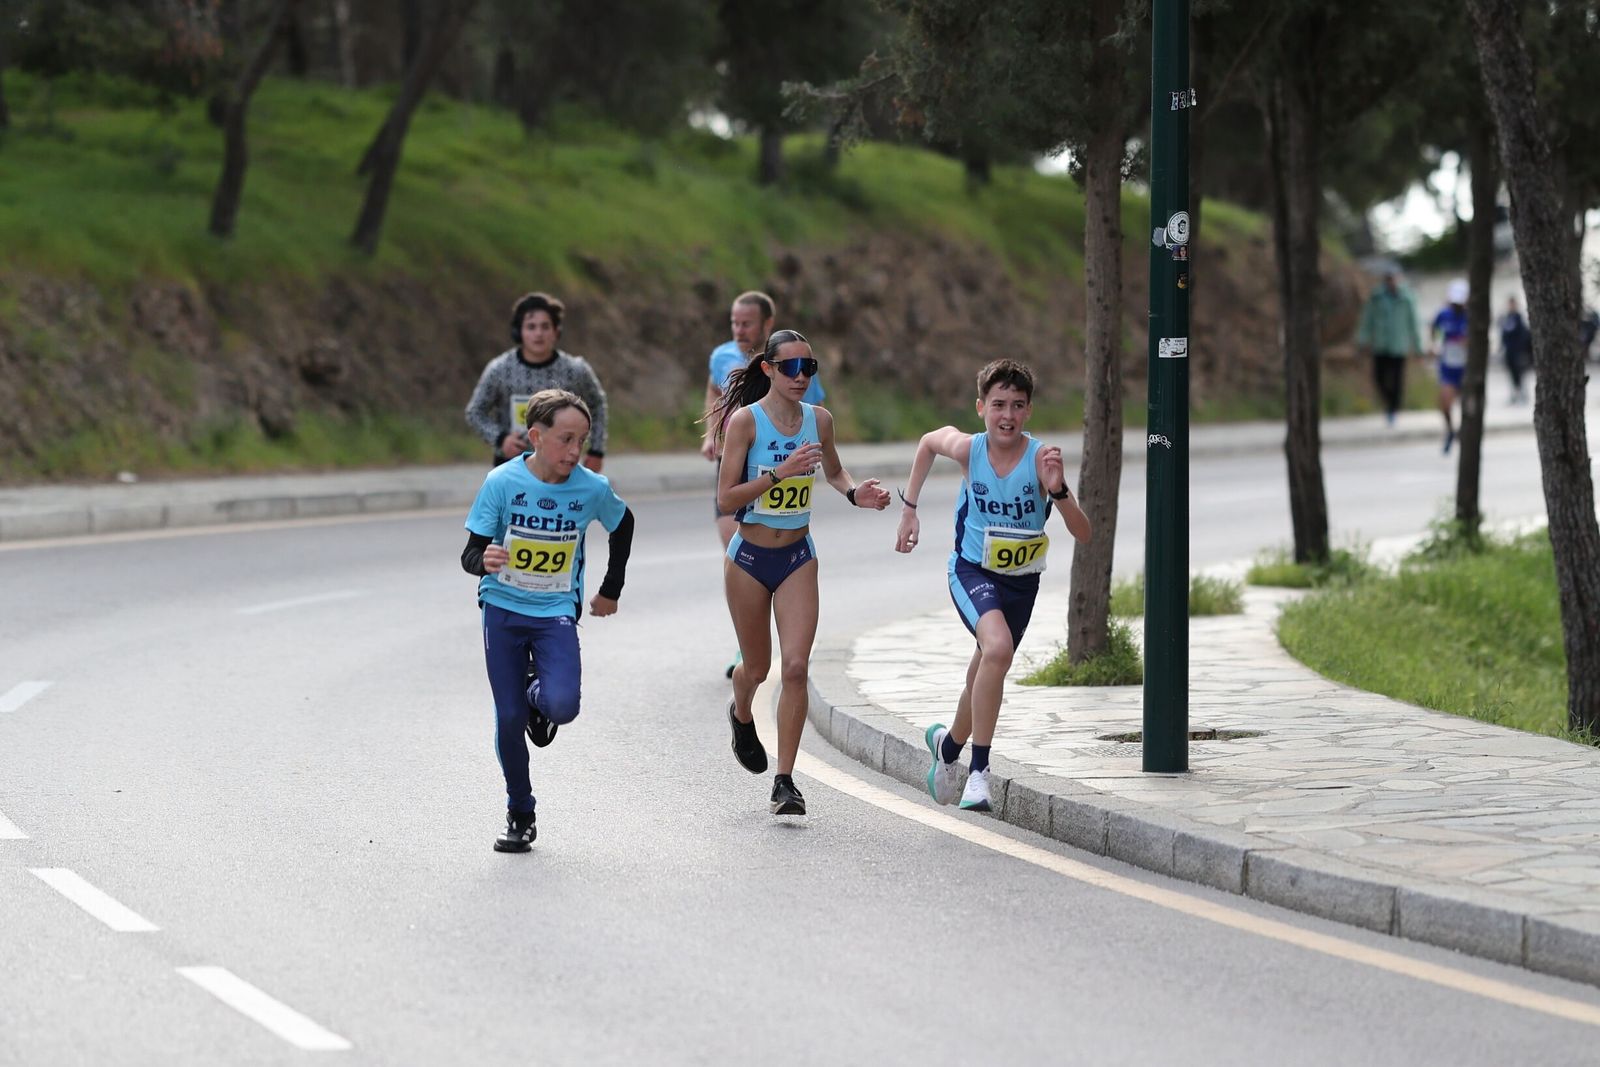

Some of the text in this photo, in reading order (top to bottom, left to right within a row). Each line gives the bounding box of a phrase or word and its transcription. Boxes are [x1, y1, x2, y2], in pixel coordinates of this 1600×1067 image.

[769, 486, 810, 509] 920
[975, 496, 1036, 521] nerja
[511, 512, 577, 532] nerja
[515, 548, 567, 573] 929
[997, 542, 1044, 568] 907
